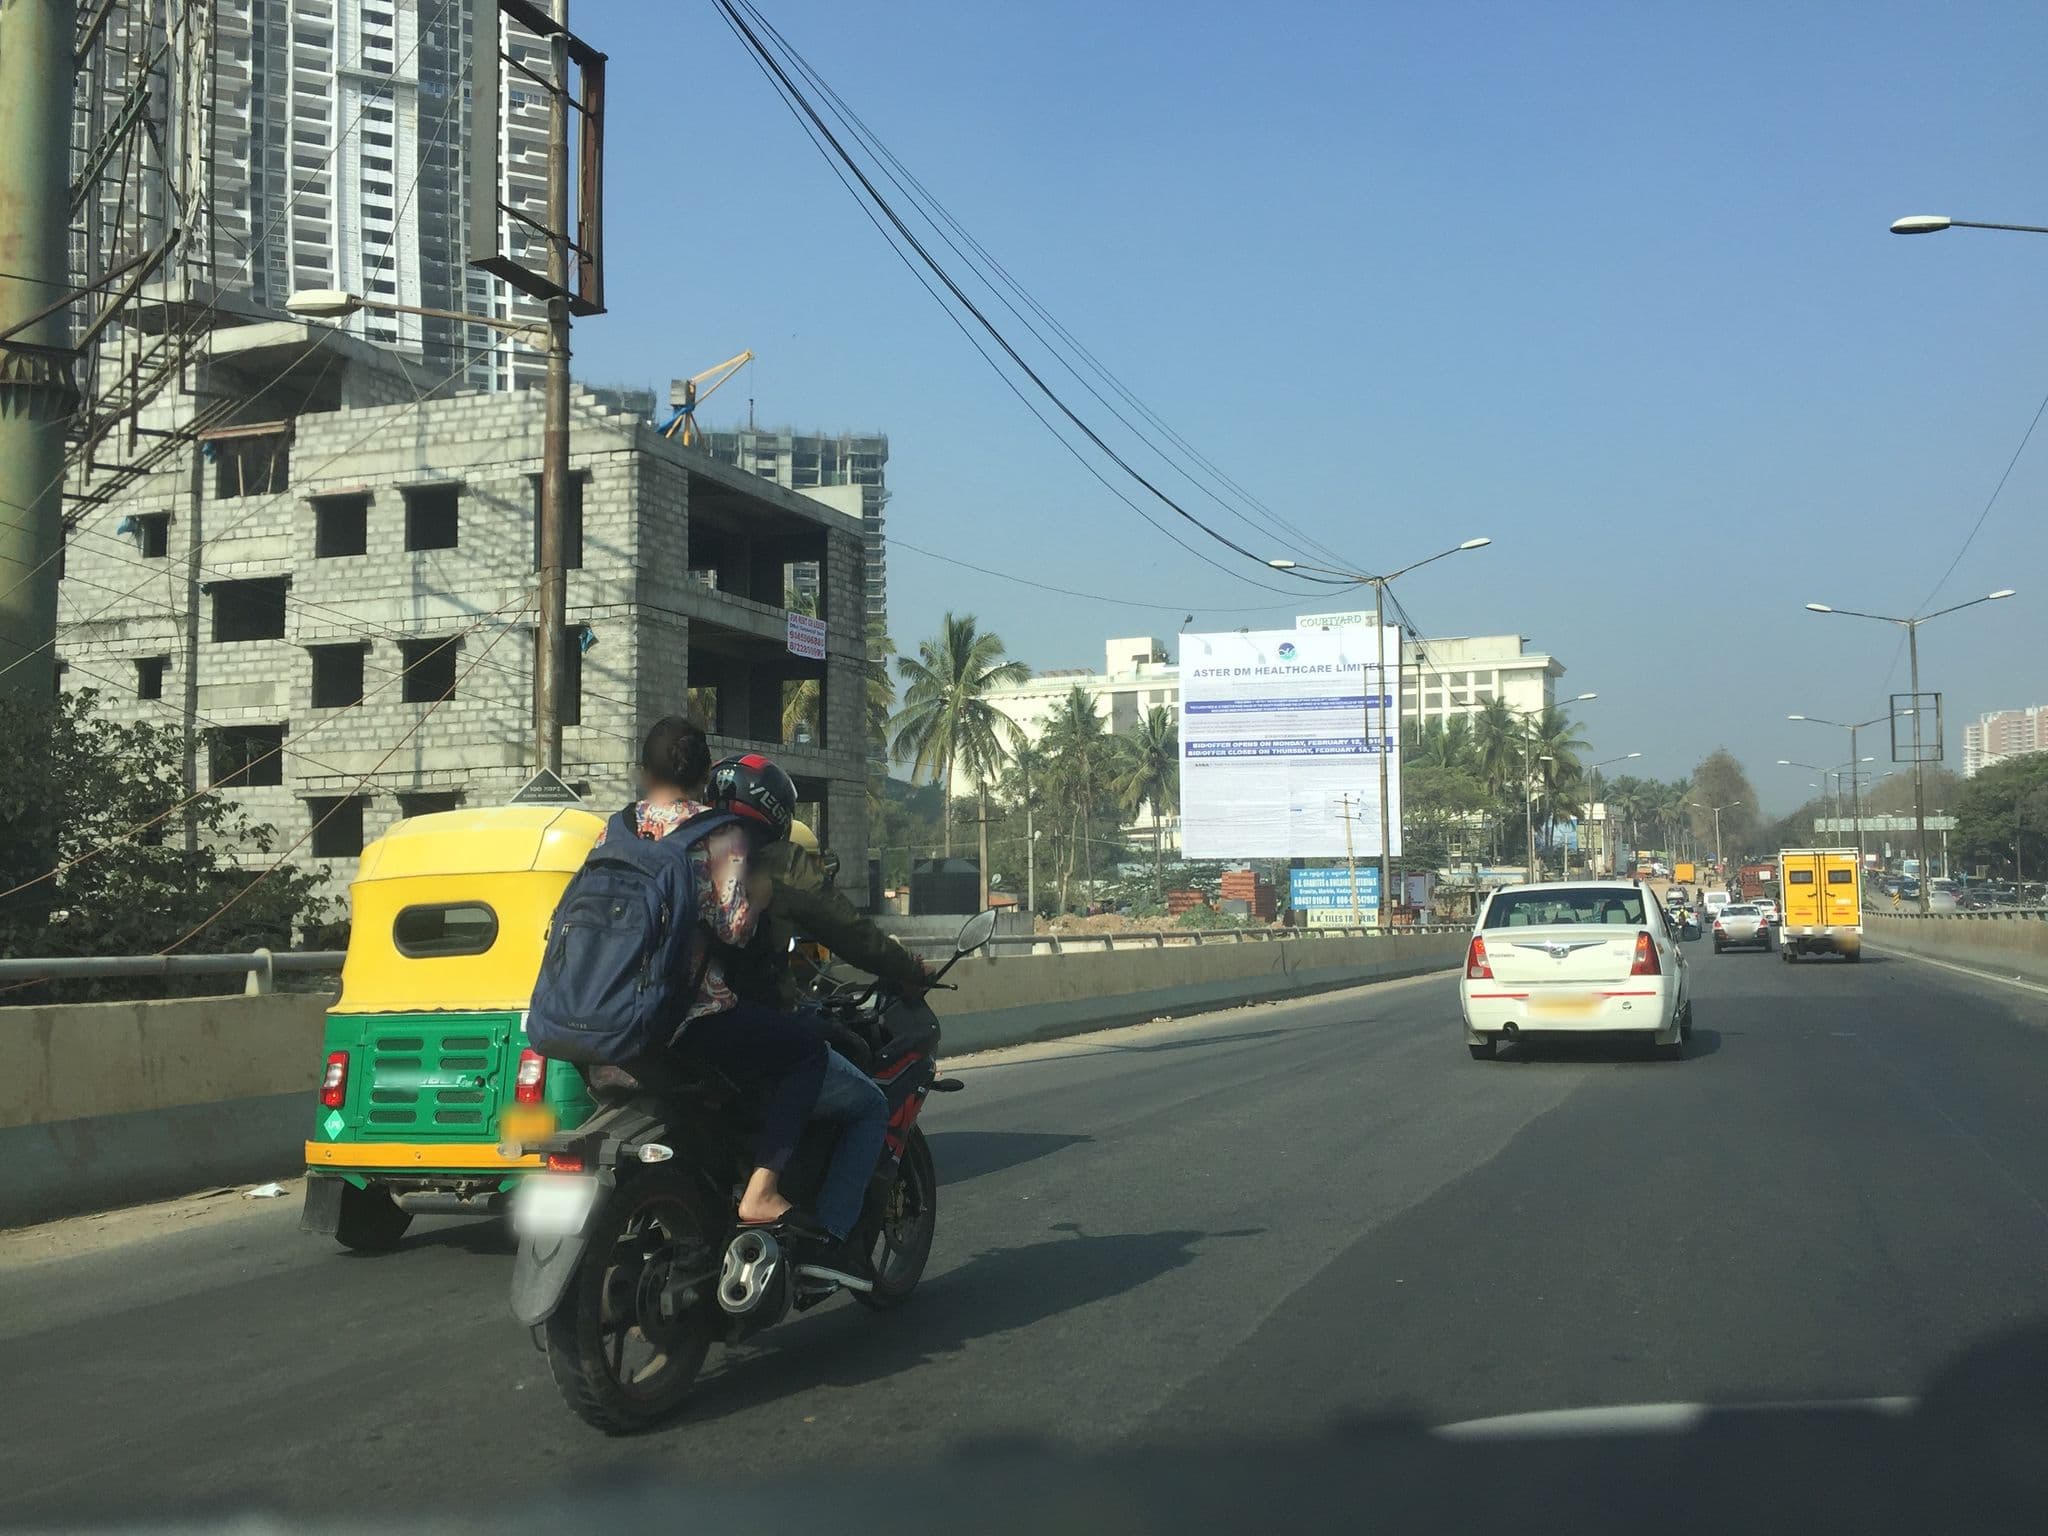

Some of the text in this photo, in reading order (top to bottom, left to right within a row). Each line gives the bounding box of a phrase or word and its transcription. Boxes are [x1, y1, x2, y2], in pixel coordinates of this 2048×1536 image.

[1300, 614, 1361, 628] COURTYARD
[1193, 662, 1383, 678] ASTER DM HEALTHCARE LIMITE
[1307, 739, 1350, 747] FEBRUARY
[1259, 748, 1270, 756] ON
[1315, 746, 1357, 754] FEBRUARY
[1325, 915, 1344, 923] TILES
